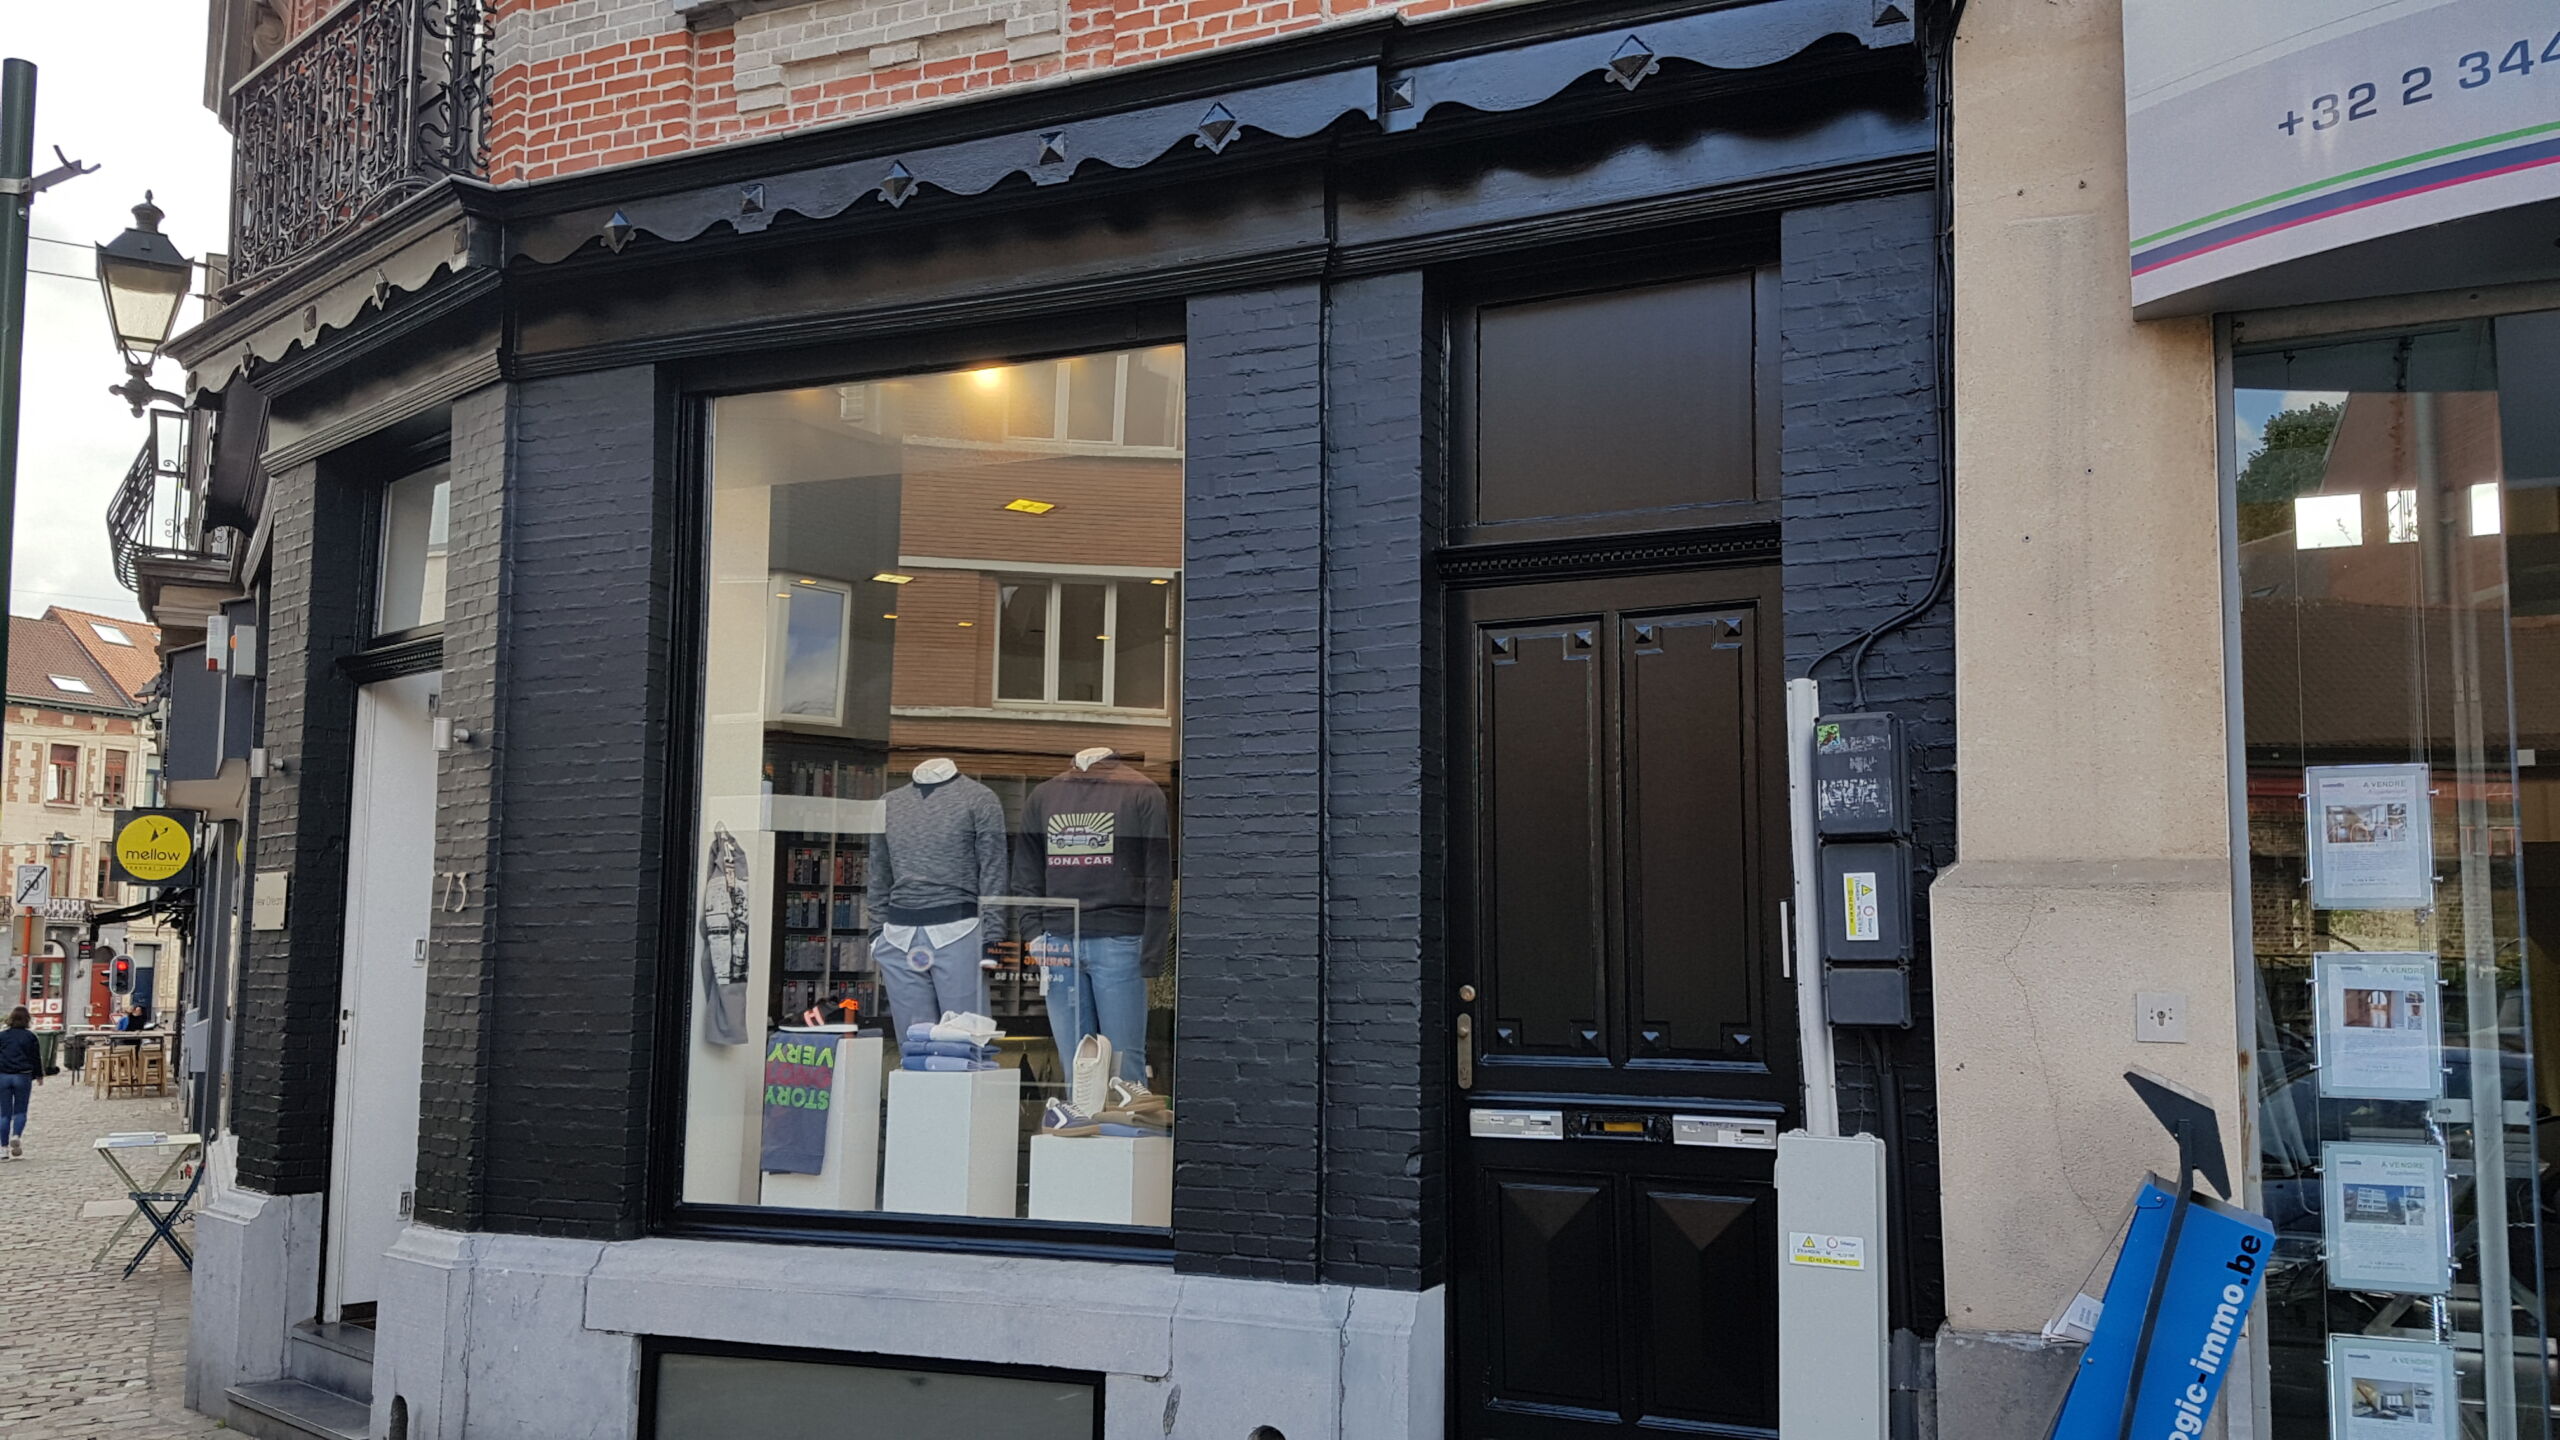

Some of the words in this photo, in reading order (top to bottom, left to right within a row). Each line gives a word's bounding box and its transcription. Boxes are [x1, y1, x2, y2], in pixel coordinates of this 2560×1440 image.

[2277, 82, 2378, 136] +32
[2402, 66, 2434, 106] 2
[125, 848, 181, 861] mellow
[1047, 856, 1080, 866] SONA
[1083, 856, 1112, 865] CAR
[24, 879, 40, 891] 30
[442, 872, 467, 912] 73
[767, 1042, 834, 1068] VERY
[765, 1085, 830, 1110] STORY
